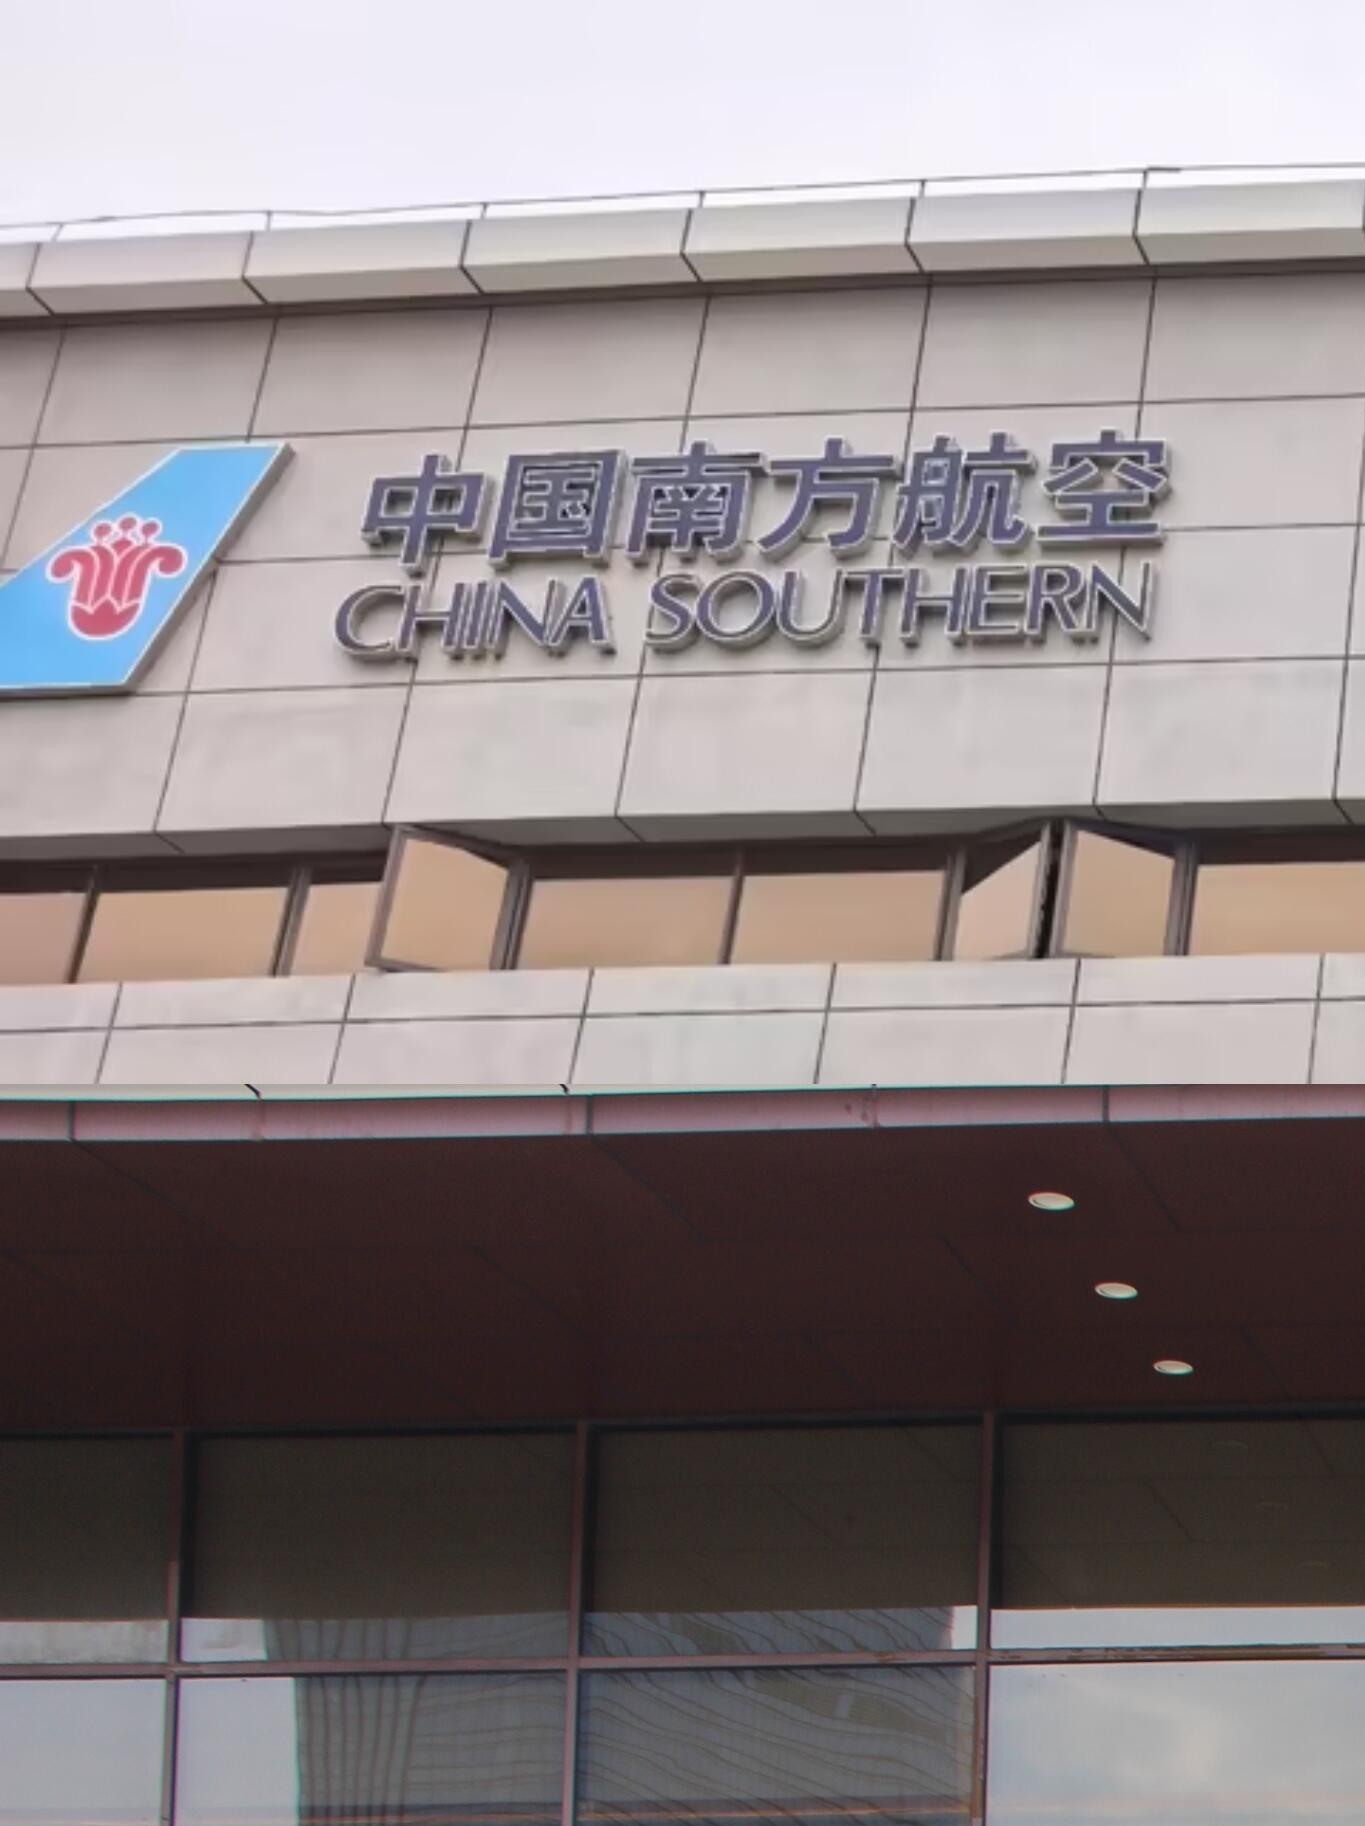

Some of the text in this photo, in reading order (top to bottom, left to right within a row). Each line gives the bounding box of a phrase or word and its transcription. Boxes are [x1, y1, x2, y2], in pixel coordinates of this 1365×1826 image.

[361, 428, 1172, 578] 中国南方航空
[335, 560, 1156, 660] CHINA SOUTHERN
